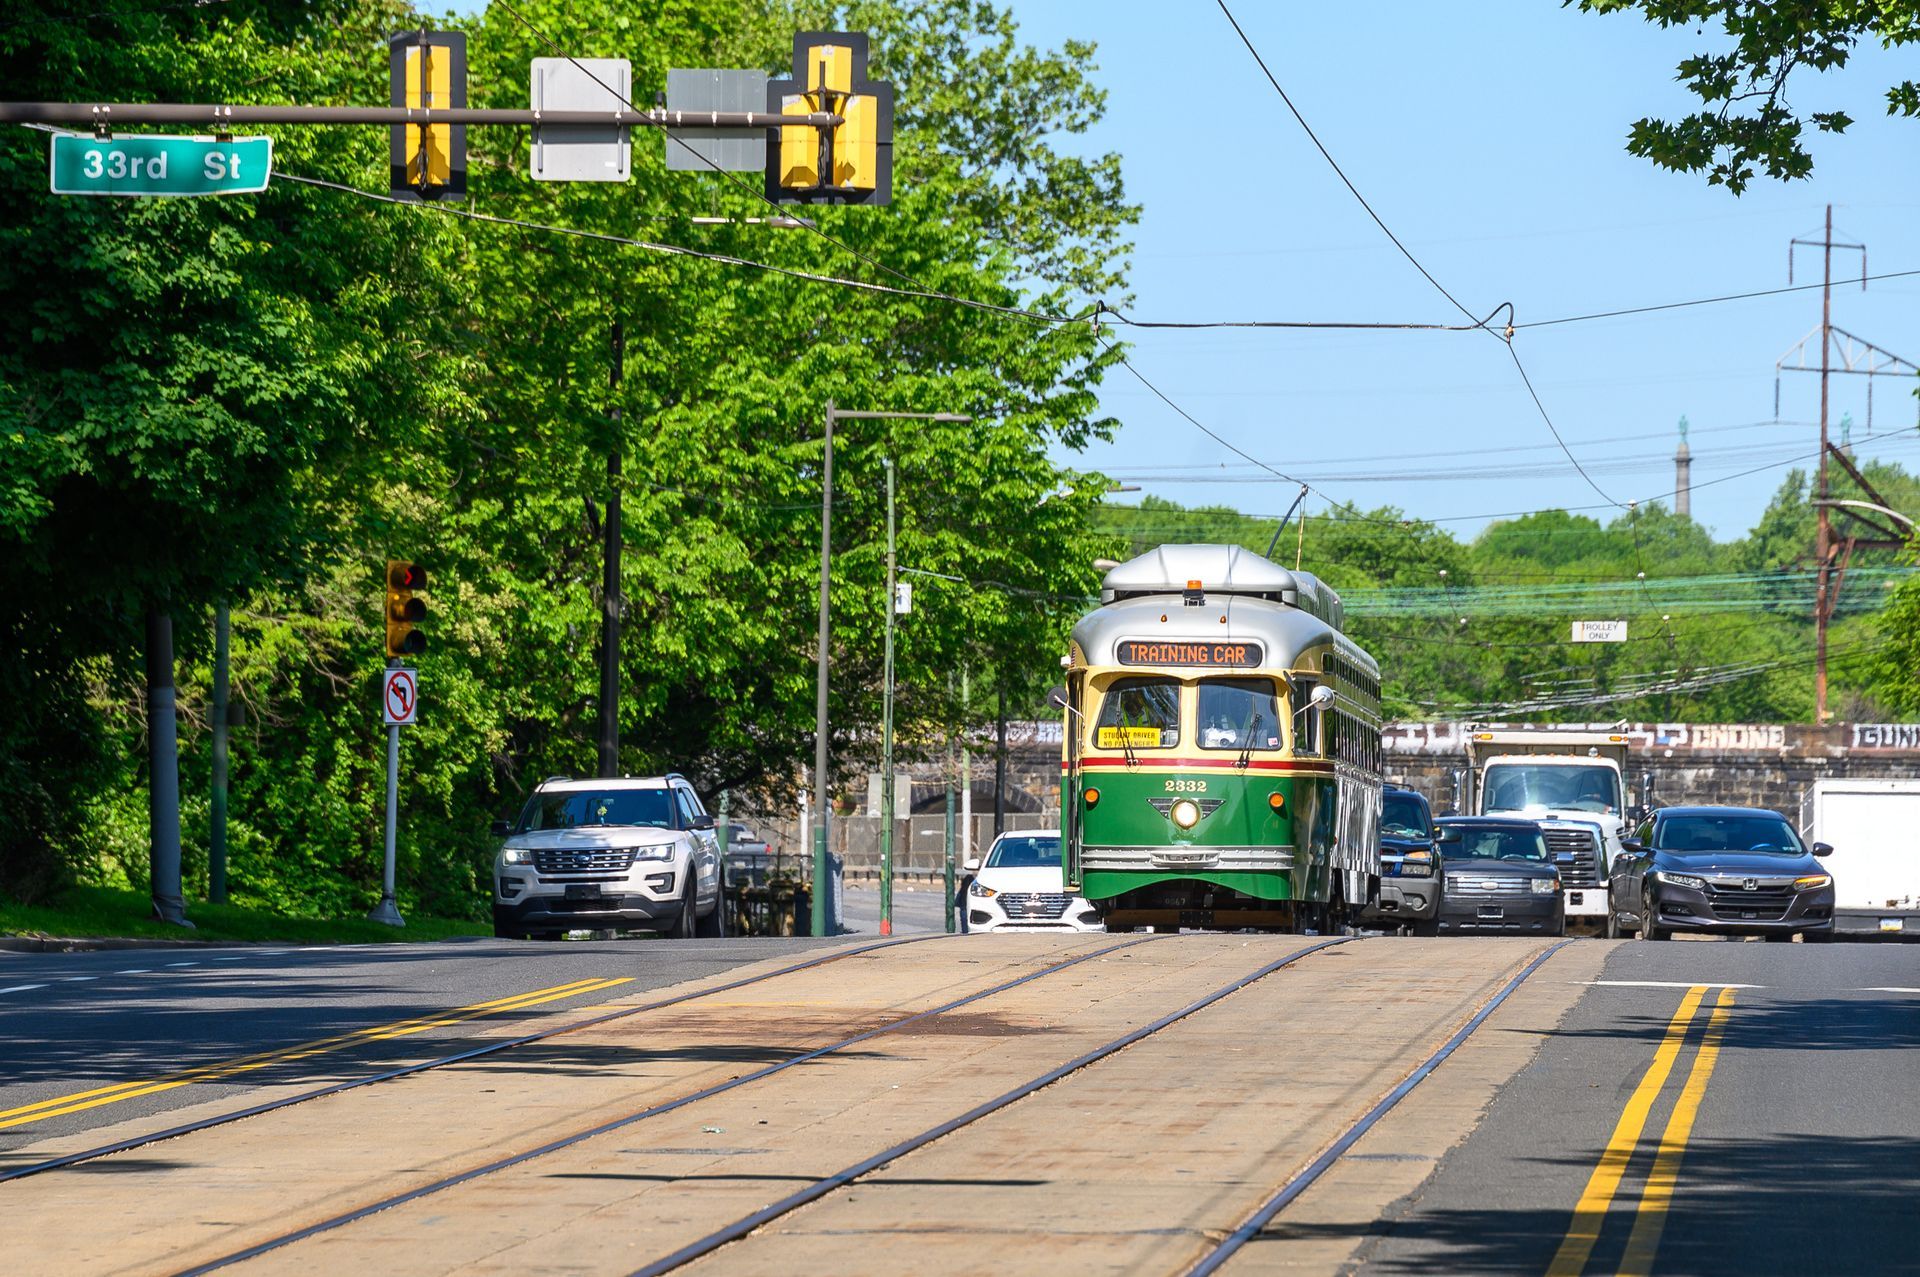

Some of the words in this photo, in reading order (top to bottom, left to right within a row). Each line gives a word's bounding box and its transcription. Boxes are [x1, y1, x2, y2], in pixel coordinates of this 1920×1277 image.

[83, 150, 168, 179] 33rd
[203, 151, 241, 180] St
[1582, 623, 1617, 631] TROLLEY
[1589, 632, 1609, 640] ONLY
[1129, 644, 1208, 663] TRAINING
[1213, 646, 1246, 664] CAR
[1165, 780, 1207, 792] 2332
